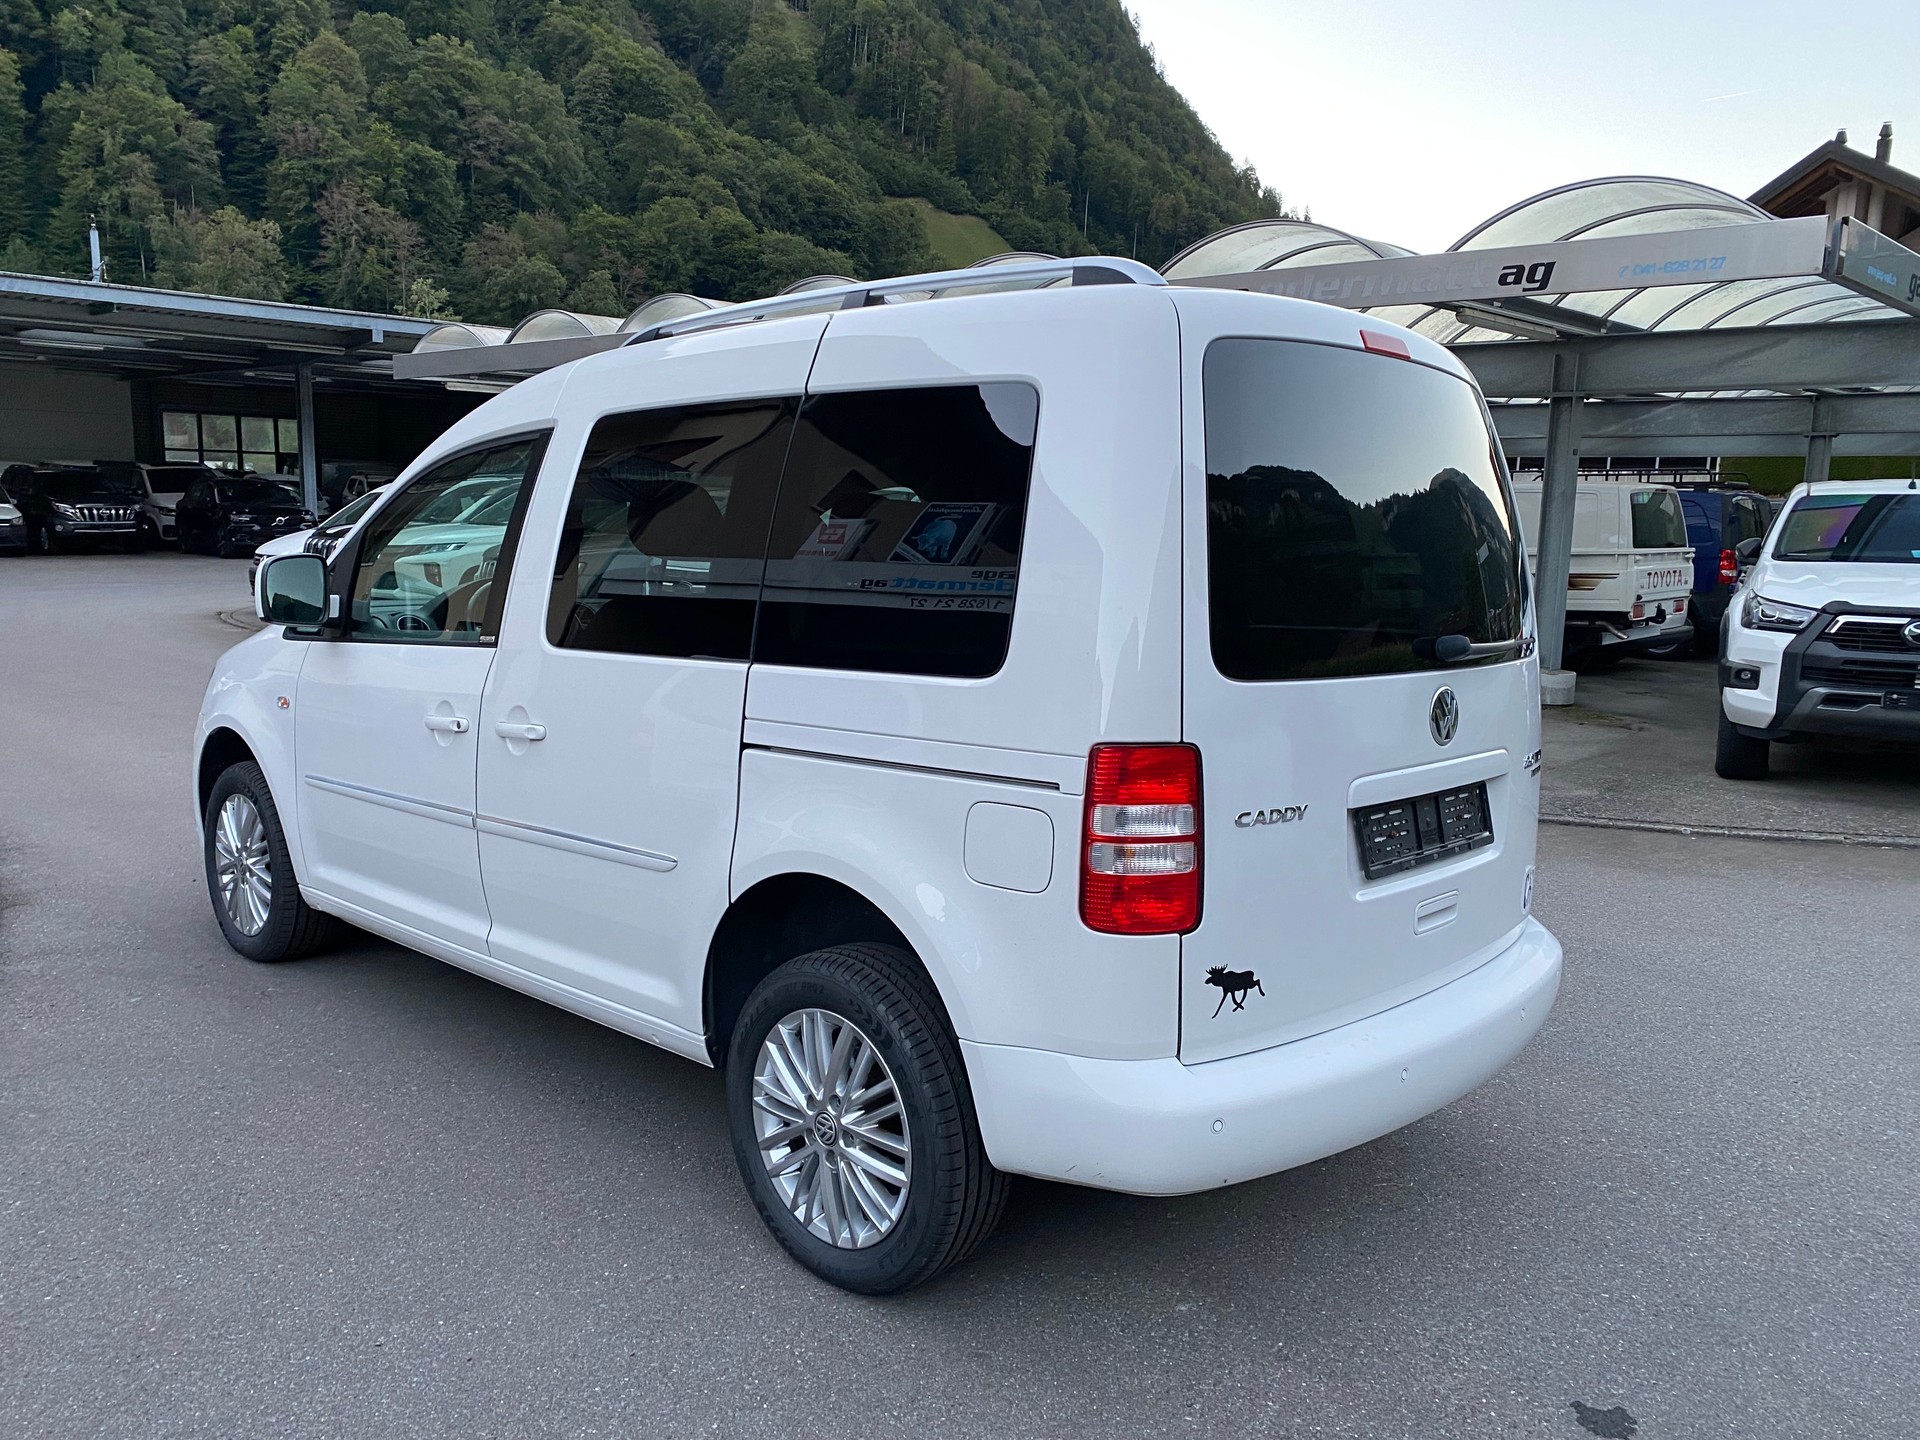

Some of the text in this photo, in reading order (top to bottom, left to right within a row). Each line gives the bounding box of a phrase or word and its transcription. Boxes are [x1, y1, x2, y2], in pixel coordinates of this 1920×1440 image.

[1709, 256, 1727, 271] 27
[1498, 261, 1556, 292] ag
[1647, 569, 1683, 589] TOYOTA
[1234, 804, 1308, 828] CADDY
